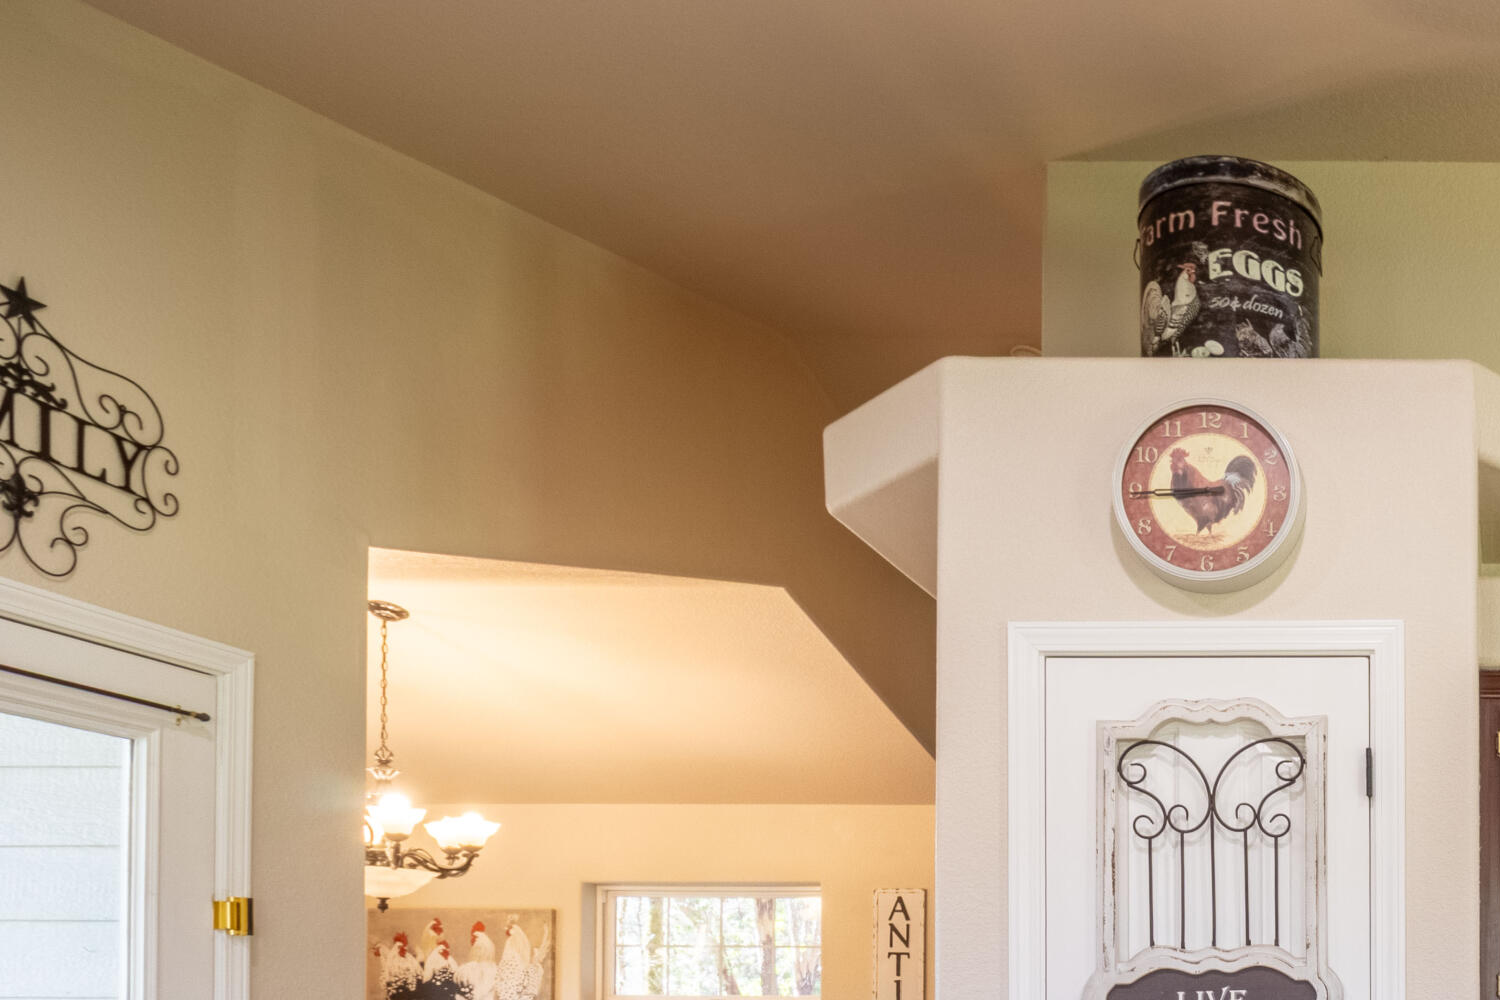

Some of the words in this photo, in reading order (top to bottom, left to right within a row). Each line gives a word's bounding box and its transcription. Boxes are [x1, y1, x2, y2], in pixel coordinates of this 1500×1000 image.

[1211, 200, 1302, 250] Fresh
[1208, 247, 1304, 297] EGGS
[1243, 294, 1283, 319] dozen
[1162, 420, 1182, 438] 11
[1199, 411, 1222, 430] 12
[1240, 423, 1249, 438] 1
[1136, 446, 1159, 464] 10
[1264, 449, 1279, 465] 2
[1128, 482, 1143, 499] 9
[1273, 484, 1287, 503] 3
[1138, 518, 1152, 535] 8
[1264, 521, 1277, 537] 4
[1165, 545, 1177, 562] 7
[1236, 546, 1250, 563] 5
[1200, 555, 1214, 572] 6
